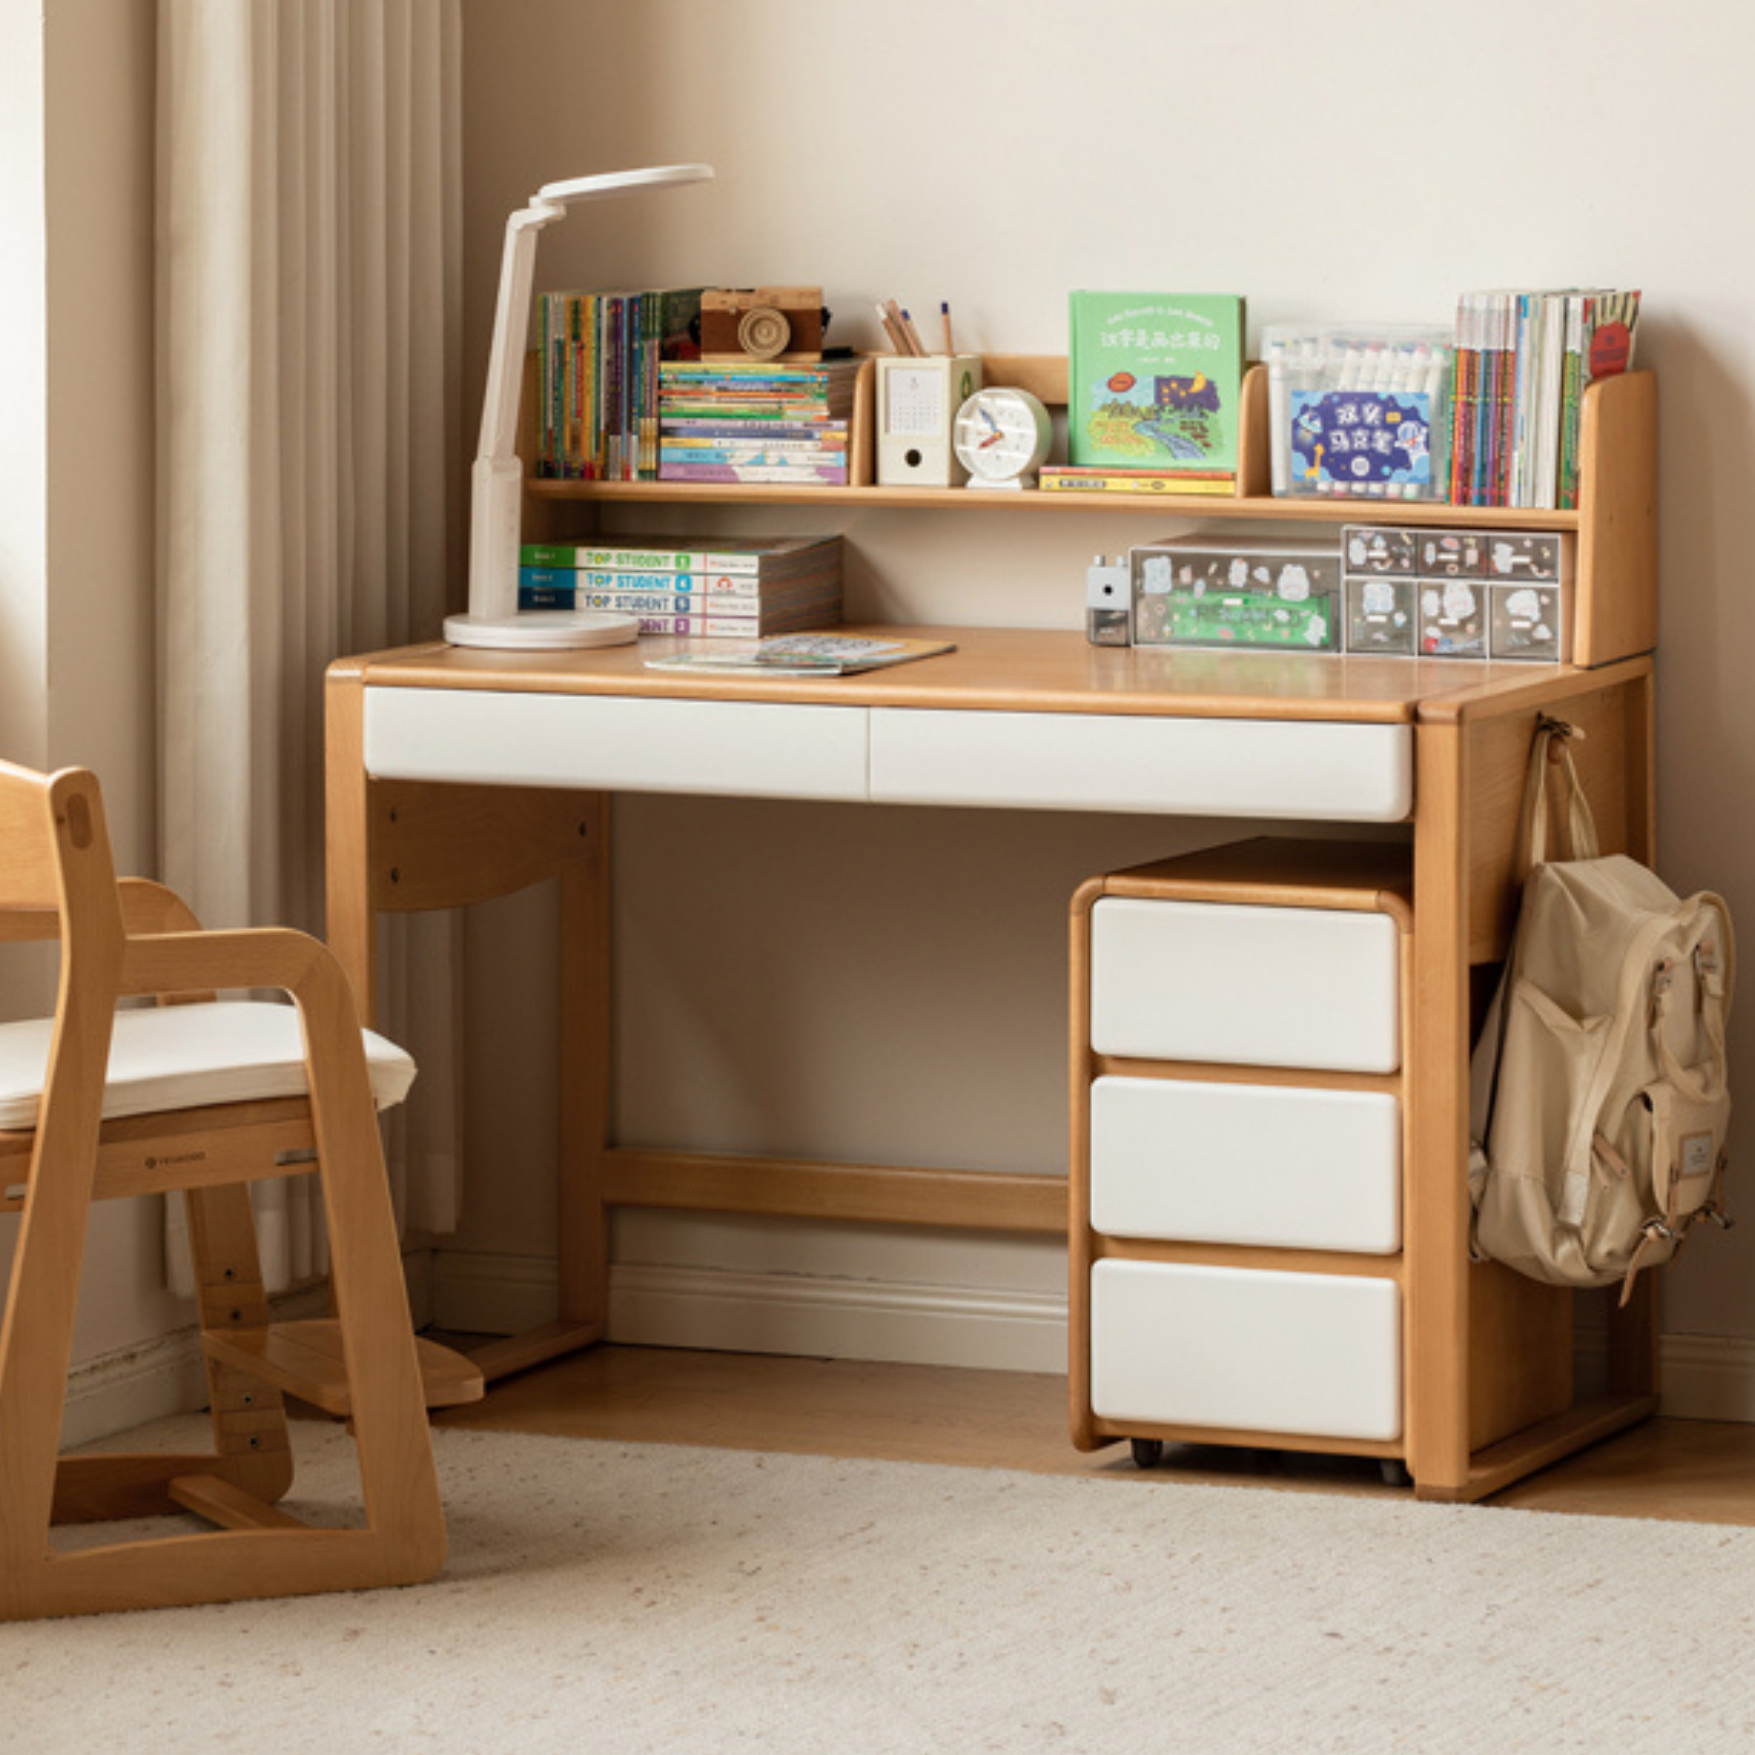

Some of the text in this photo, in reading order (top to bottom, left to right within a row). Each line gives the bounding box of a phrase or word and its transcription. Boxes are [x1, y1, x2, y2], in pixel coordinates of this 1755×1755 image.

[585, 551, 613, 566] TOP
[615, 552, 671, 568] STUDENT
[586, 572, 613, 586] TOP
[617, 574, 672, 590] STUDENT
[585, 594, 612, 608] TOP
[614, 595, 670, 611] STUDENT
[638, 618, 670, 633] DENT
